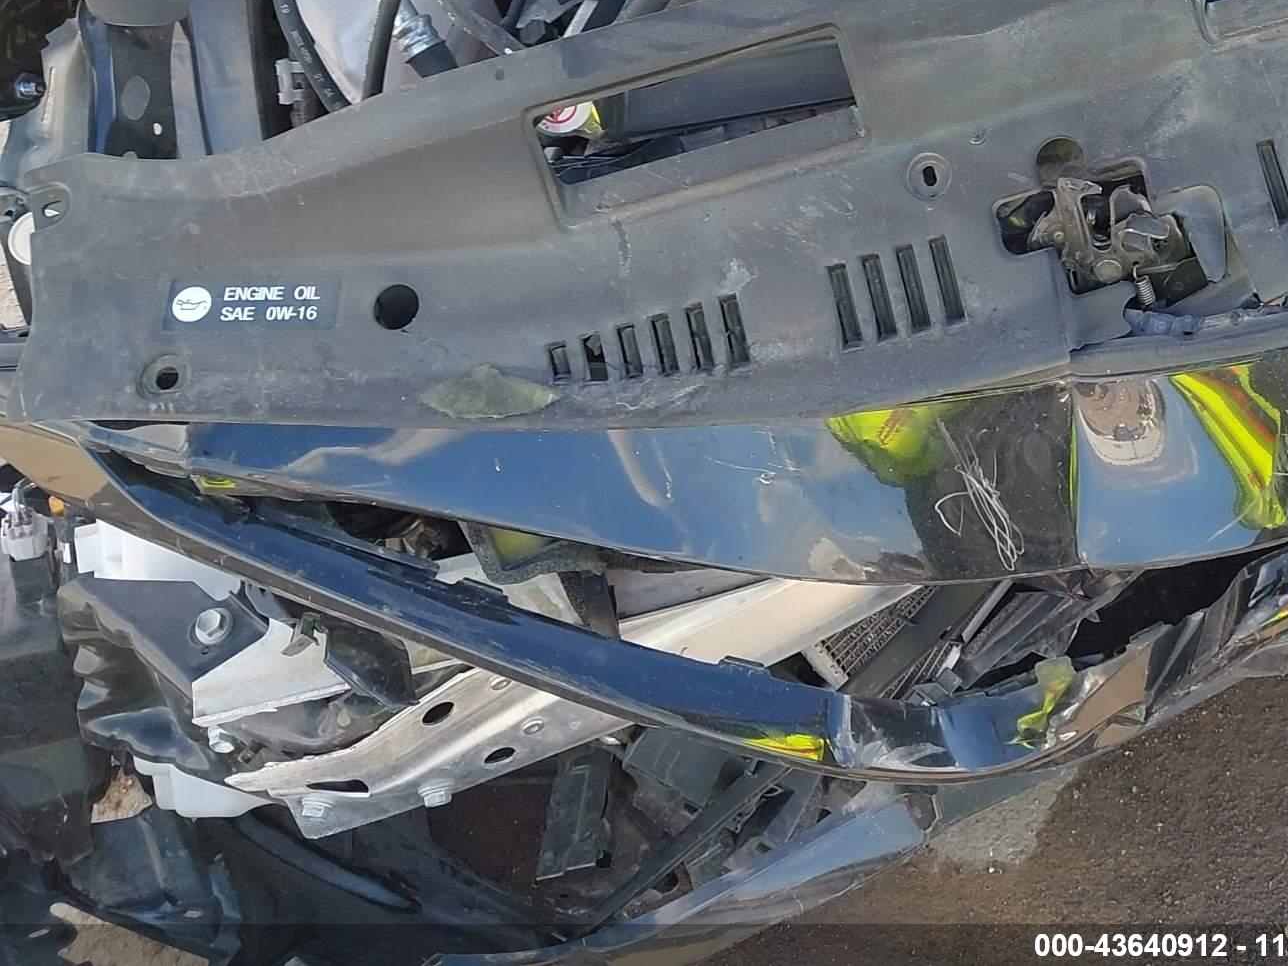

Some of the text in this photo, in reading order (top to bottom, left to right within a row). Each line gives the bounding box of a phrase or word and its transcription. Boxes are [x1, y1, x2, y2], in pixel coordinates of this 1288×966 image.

[224, 286, 320, 301] ENGINE OIL
[220, 306, 317, 321] SAE 0W-16
